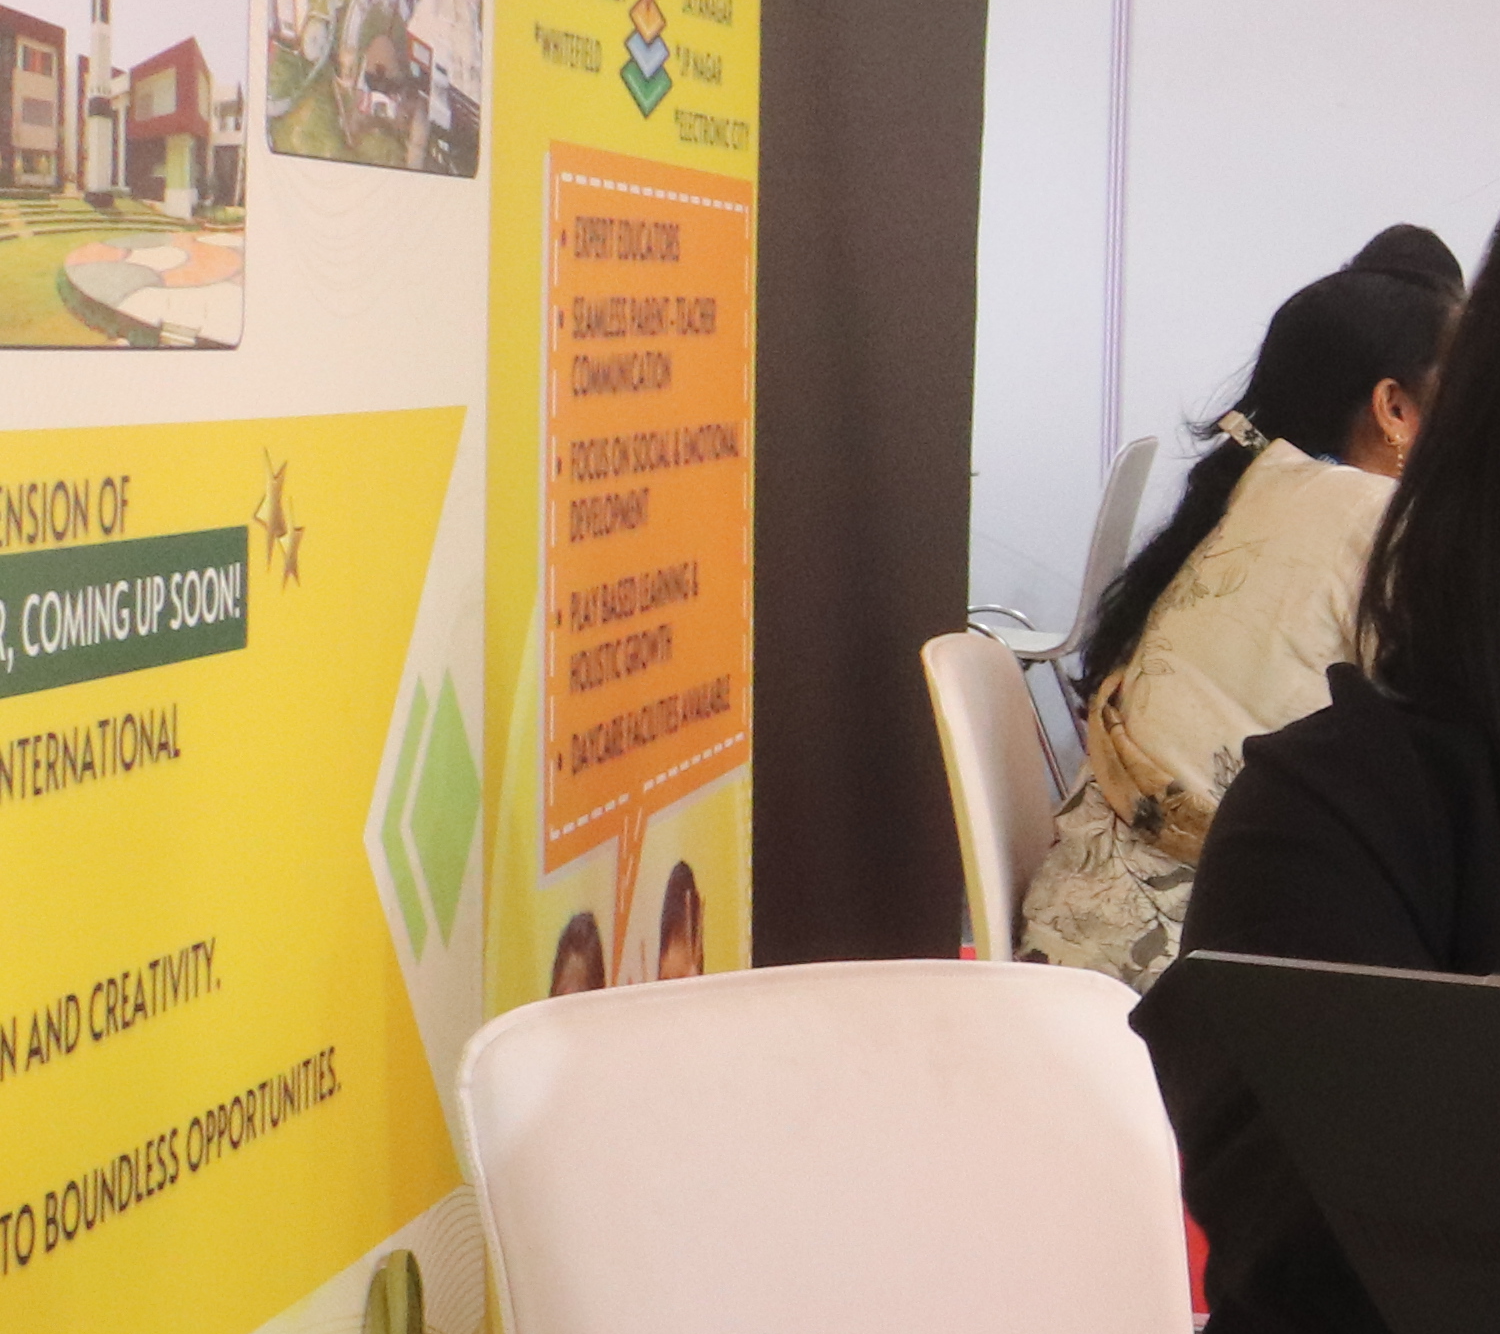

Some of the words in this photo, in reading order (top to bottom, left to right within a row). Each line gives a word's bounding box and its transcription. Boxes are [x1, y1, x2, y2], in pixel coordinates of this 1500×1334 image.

[0, 478, 90, 548] NSION
[98, 475, 130, 536] OF
[21, 579, 130, 657] COMING
[136, 575, 165, 636] UP
[169, 562, 241, 631] SOON!
[25, 992, 81, 1074] AND
[87, 936, 222, 1043] CREATIVITY.
[44, 1126, 179, 1254] BOUNDLESS
[185, 1045, 342, 1173] OPPORTUNITIES.
